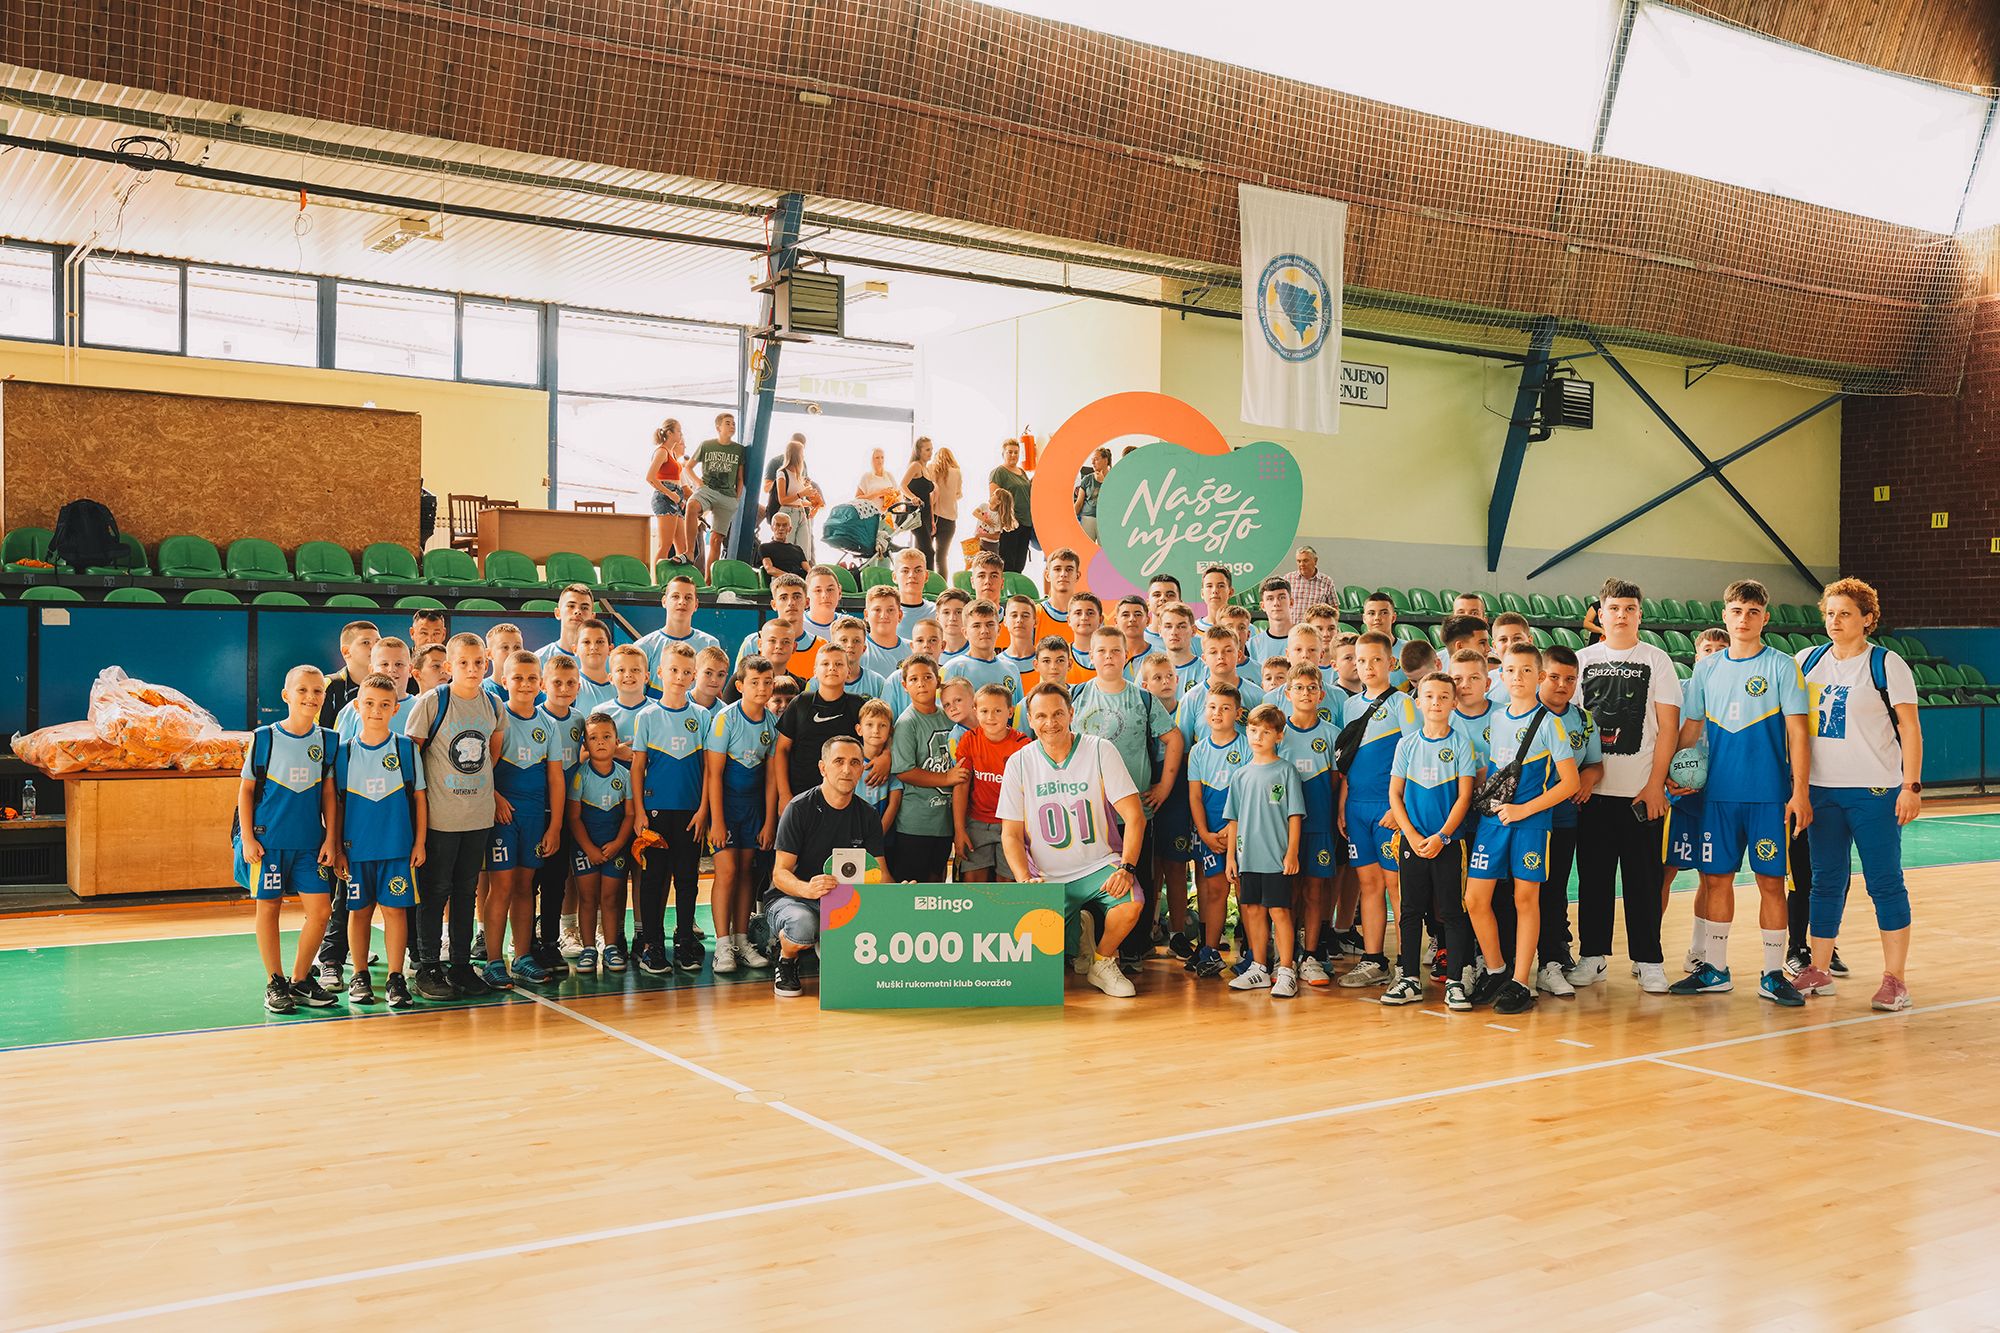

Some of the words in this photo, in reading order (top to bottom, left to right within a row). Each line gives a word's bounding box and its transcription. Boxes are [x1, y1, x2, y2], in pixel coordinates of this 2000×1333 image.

[1340, 367, 1385, 385] NJENO
[811, 377, 856, 399] IZLAZ
[704, 451, 740, 465] LONSDALE
[1121, 467, 1241, 527] Naše
[1935, 514, 1945, 526] IV
[1127, 495, 1262, 577] mjesto
[1587, 668, 1643, 679] Slazenger
[1729, 702, 1740, 720] 8
[1296, 758, 1314, 772] 50
[1673, 760, 1699, 770] SELECT
[289, 767, 309, 782] 69
[1048, 781, 1088, 796] Bingo
[1039, 799, 1095, 849] 01
[492, 846, 508, 862] 61
[1347, 844, 1359, 859] 8
[1673, 841, 1692, 861] 42
[1702, 842, 1712, 862] 8
[575, 856, 591, 871] 51
[1470, 852, 1489, 870] 56
[263, 873, 281, 890] 69
[347, 883, 360, 900] 3
[927, 895, 974, 913] Bingo
[853, 931, 964, 965] 8.000
[973, 932, 1033, 963] KM
[876, 979, 904, 989] Muški
[905, 979, 952, 989] rukometni
[953, 979, 973, 988] klub
[974, 978, 1012, 989] Goražde
